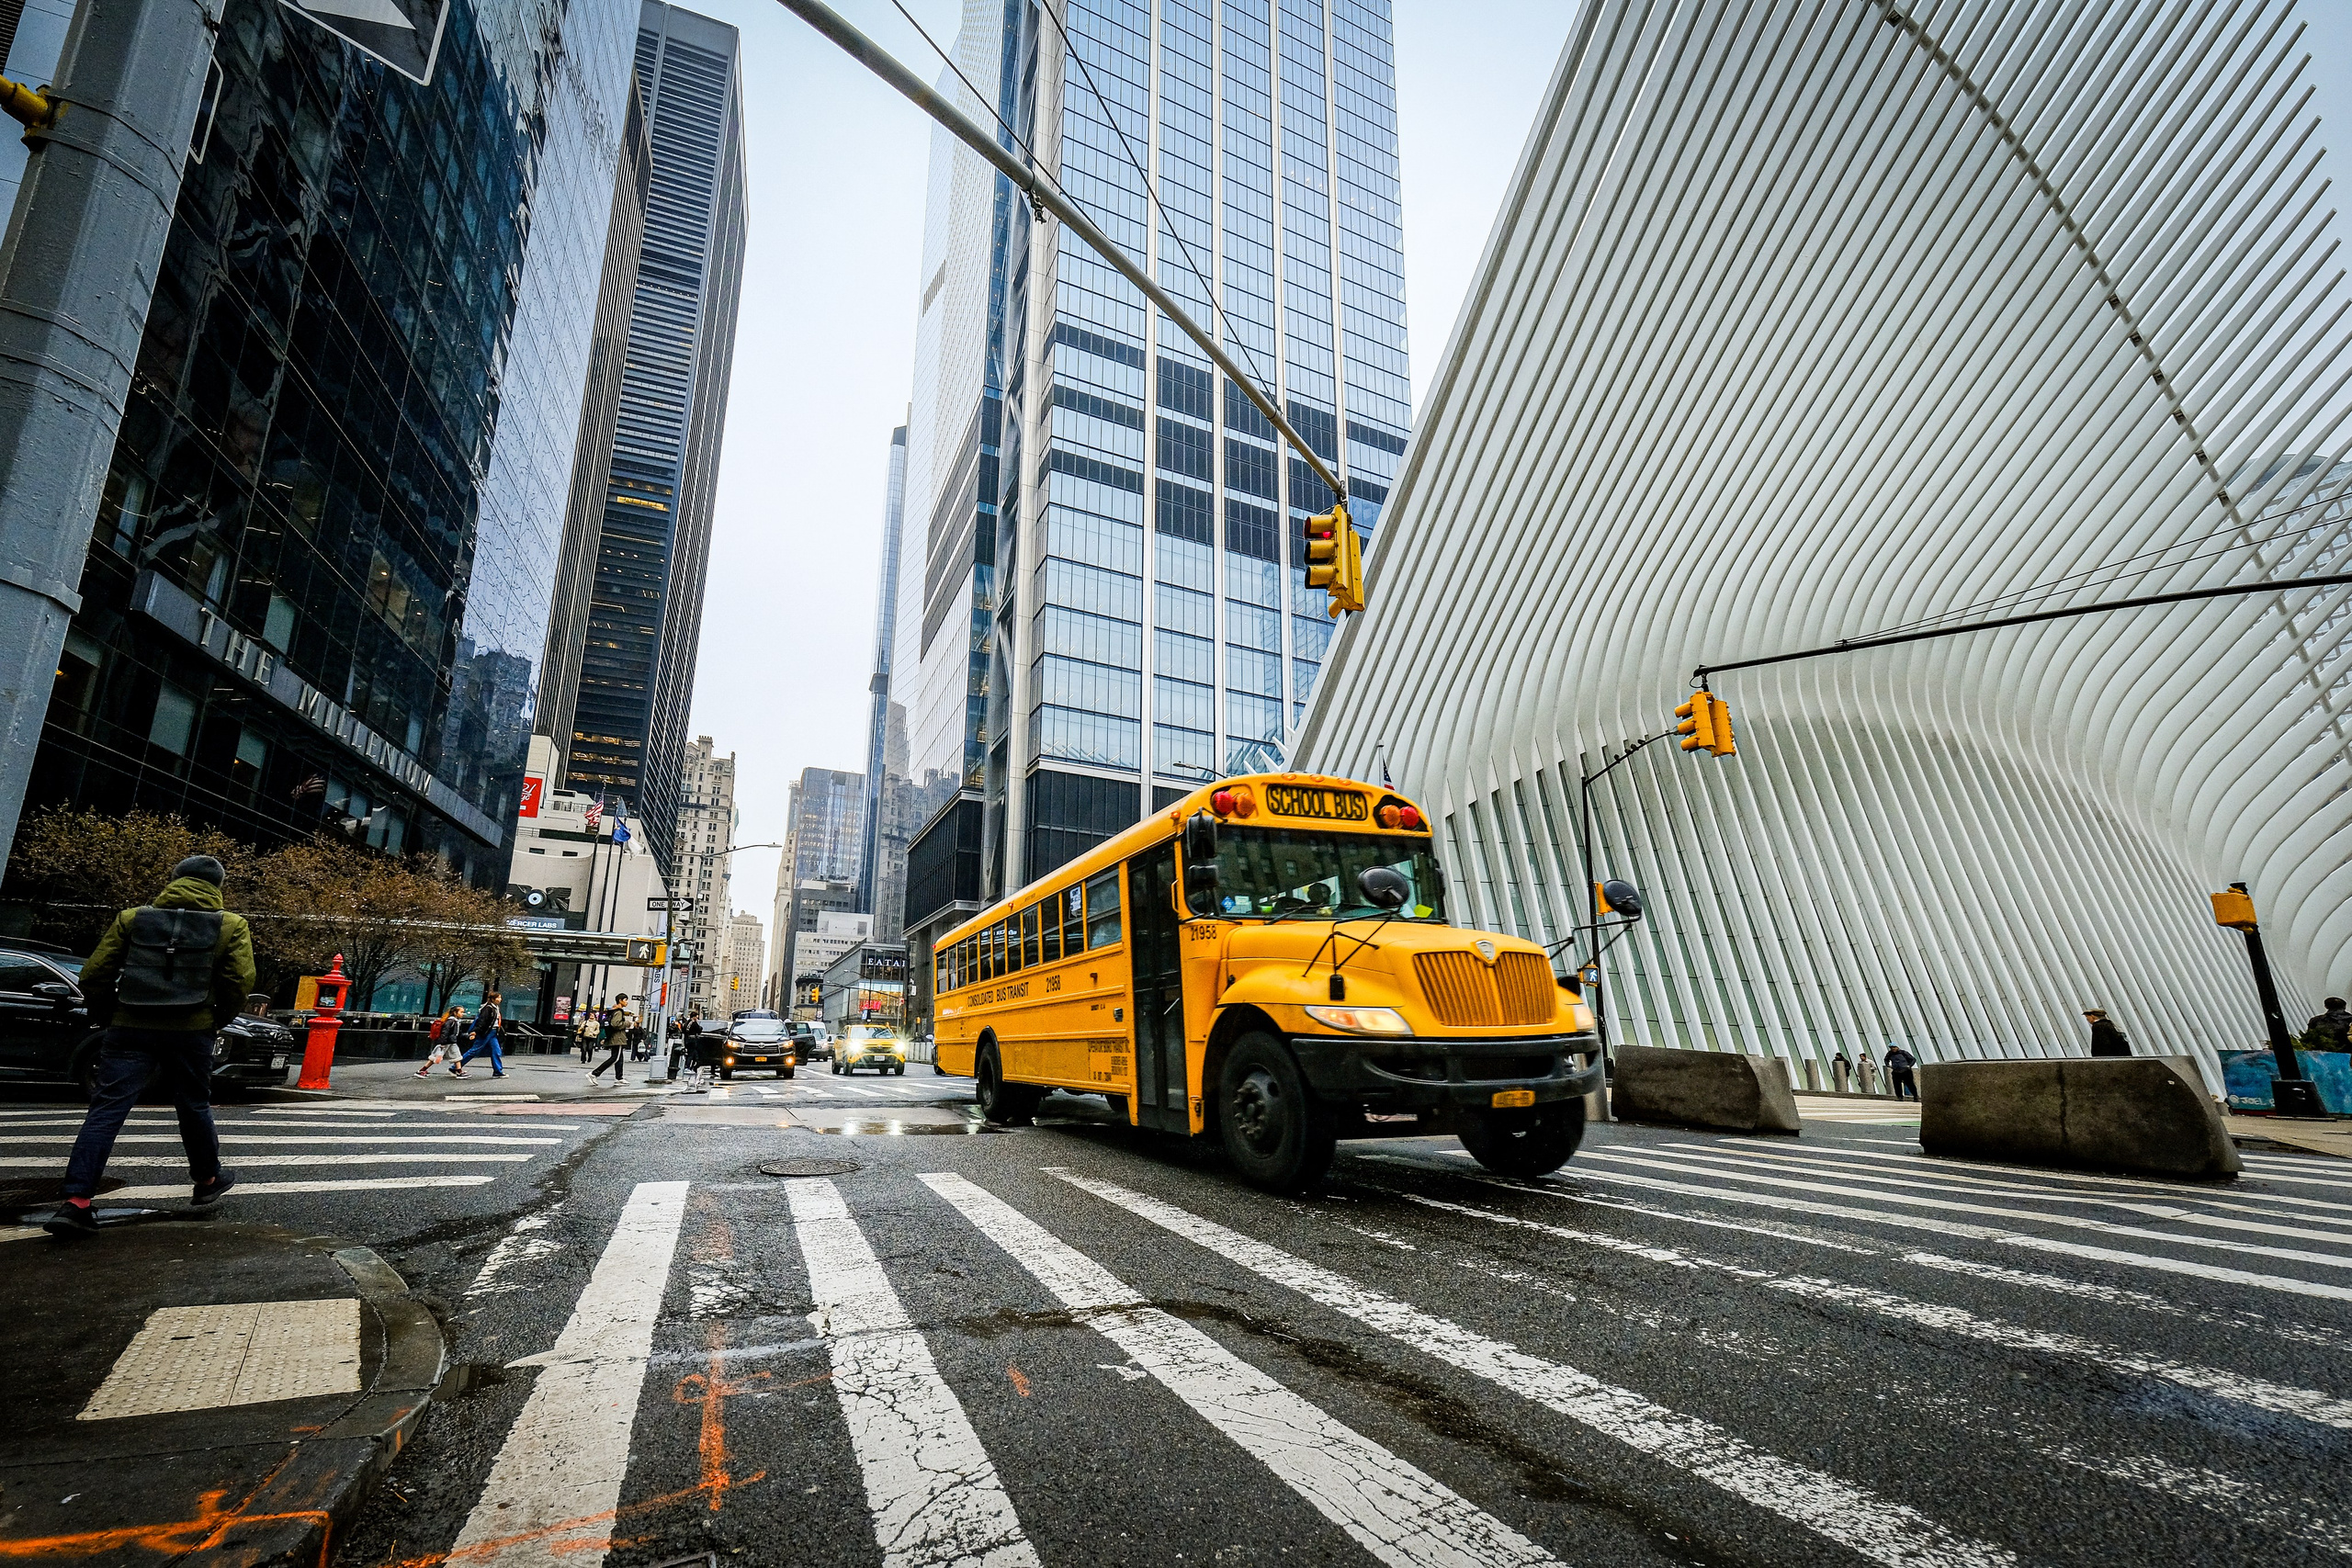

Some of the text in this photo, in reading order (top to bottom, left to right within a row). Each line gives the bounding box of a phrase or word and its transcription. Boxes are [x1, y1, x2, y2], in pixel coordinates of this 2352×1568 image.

[200, 606, 433, 797] THE MILLENIUM
[1269, 786, 1363, 819] SCHOOL BUS
[1191, 925, 1217, 942] 21958
[967, 975, 1061, 1008] CONSOLIDATED BUS TRANSIT 21958
